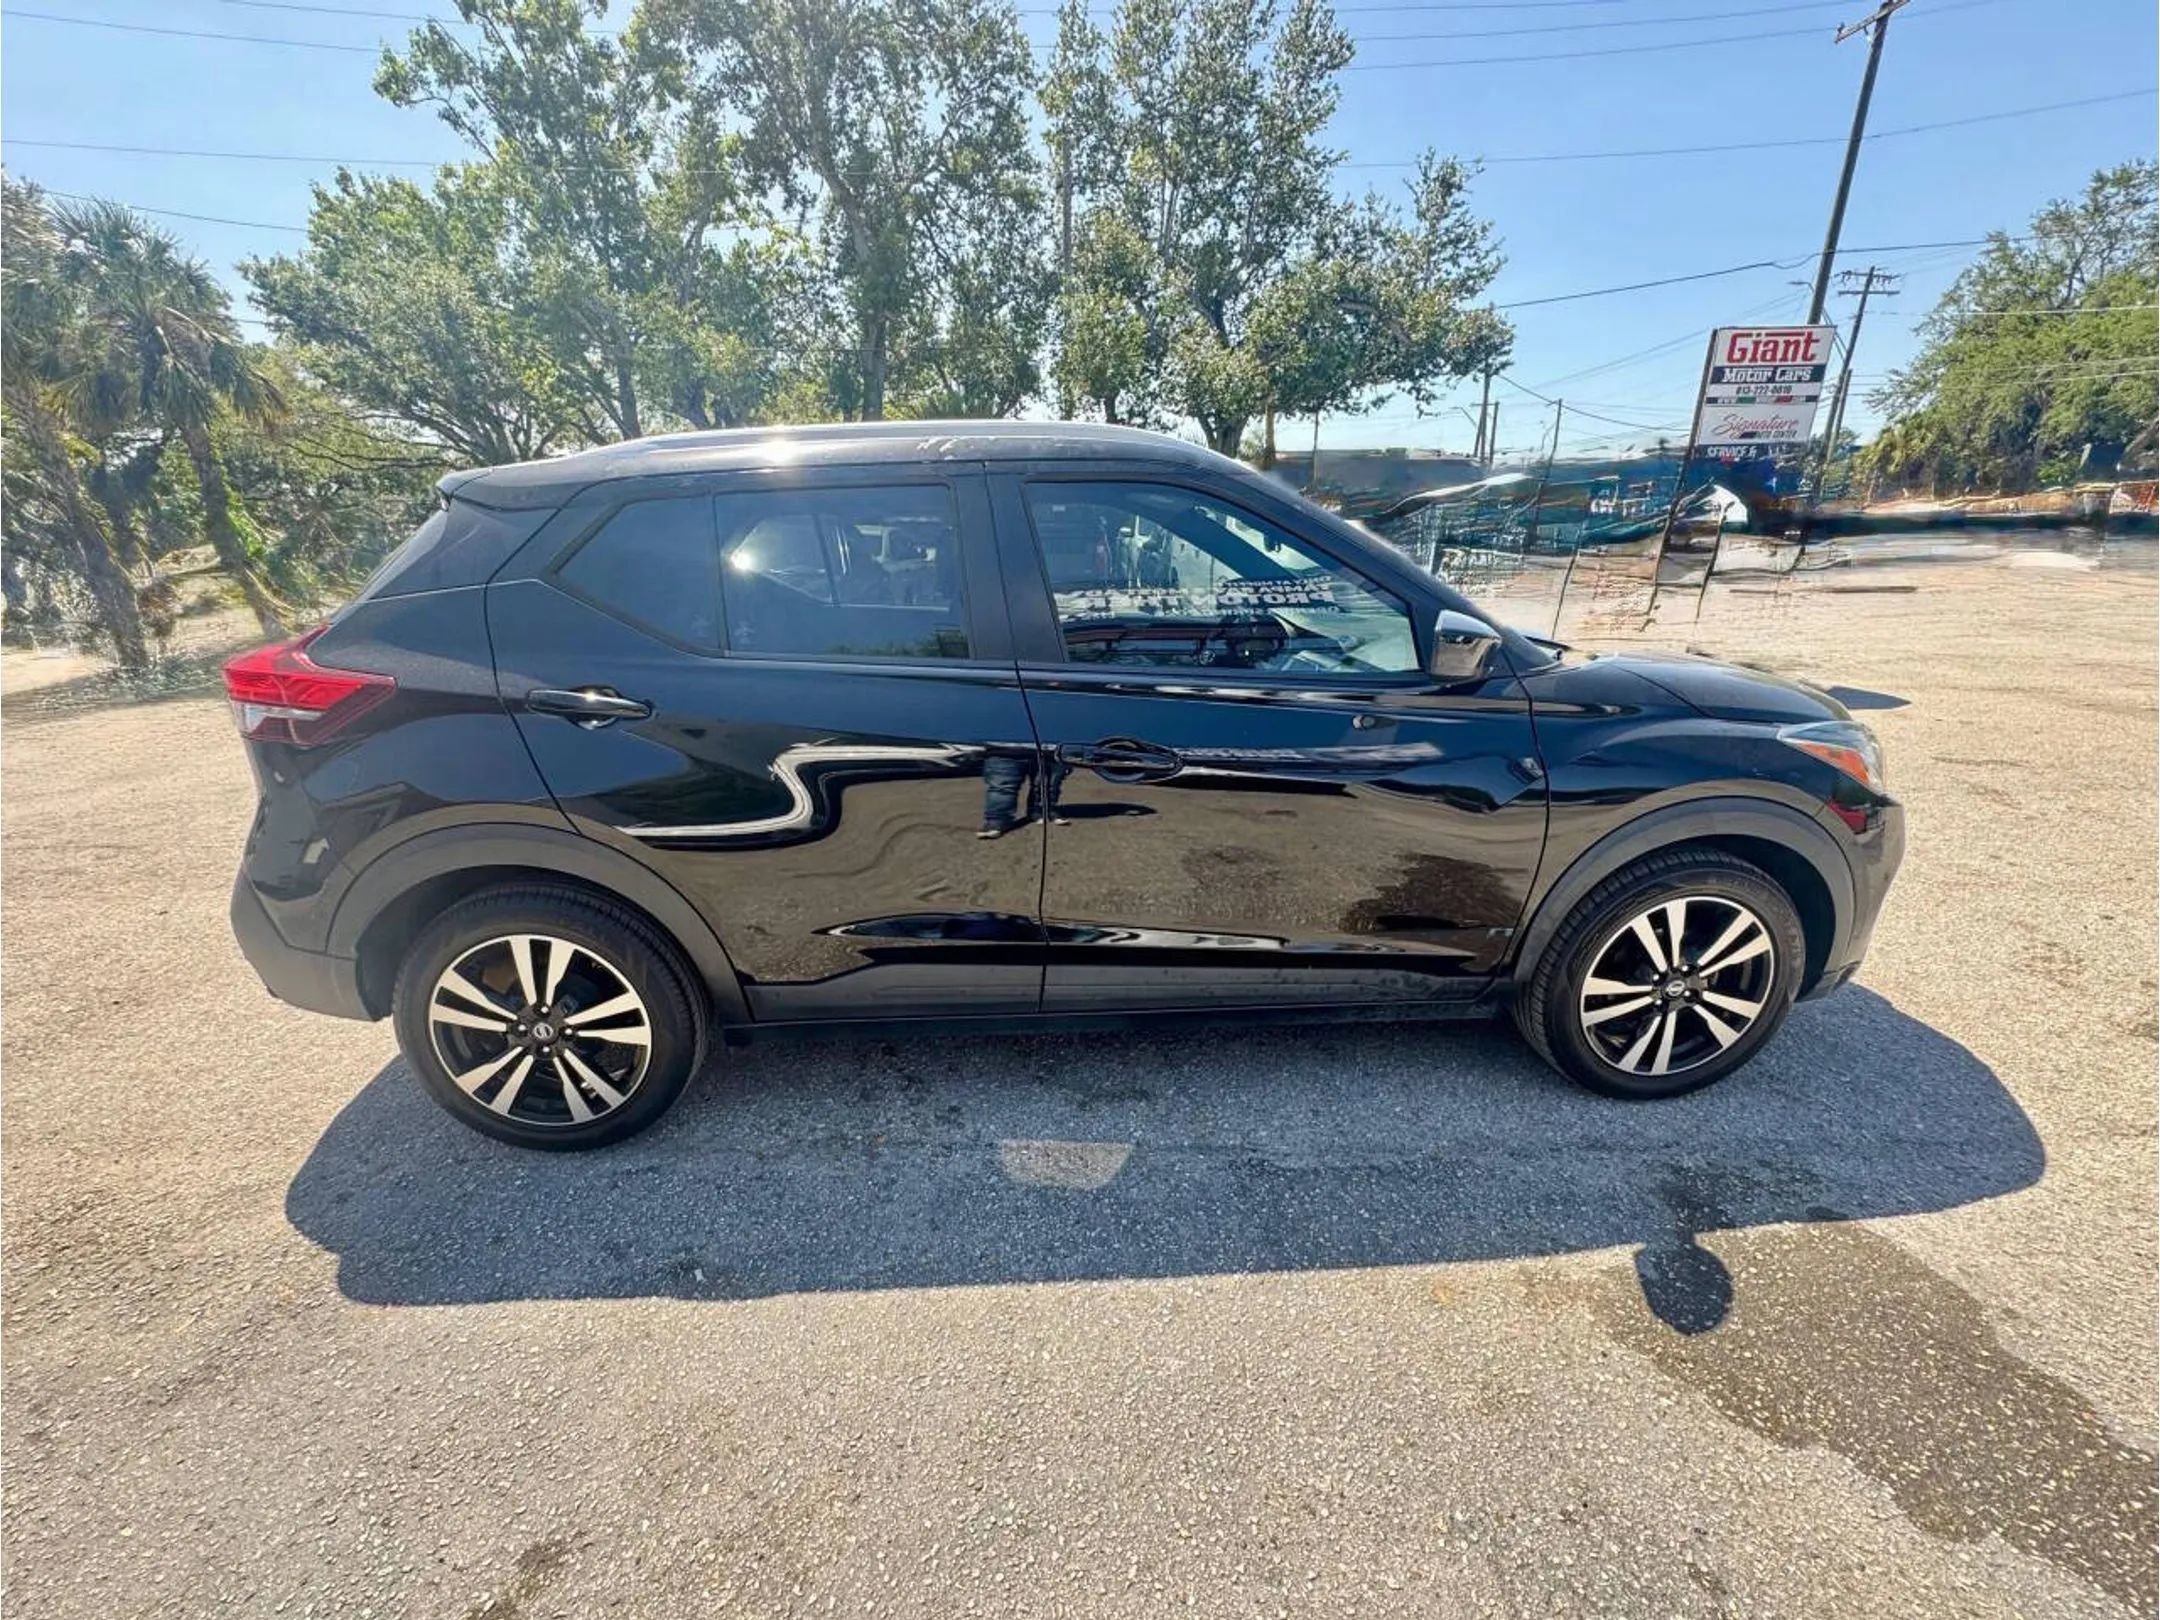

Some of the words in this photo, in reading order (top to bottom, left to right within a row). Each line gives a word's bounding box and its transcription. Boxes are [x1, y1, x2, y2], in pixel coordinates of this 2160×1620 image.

[1727, 331, 1820, 363] Giant
[1722, 367, 1774, 383] Motor
[1775, 366, 1814, 382] Cars
[1711, 413, 1799, 438] Signature
